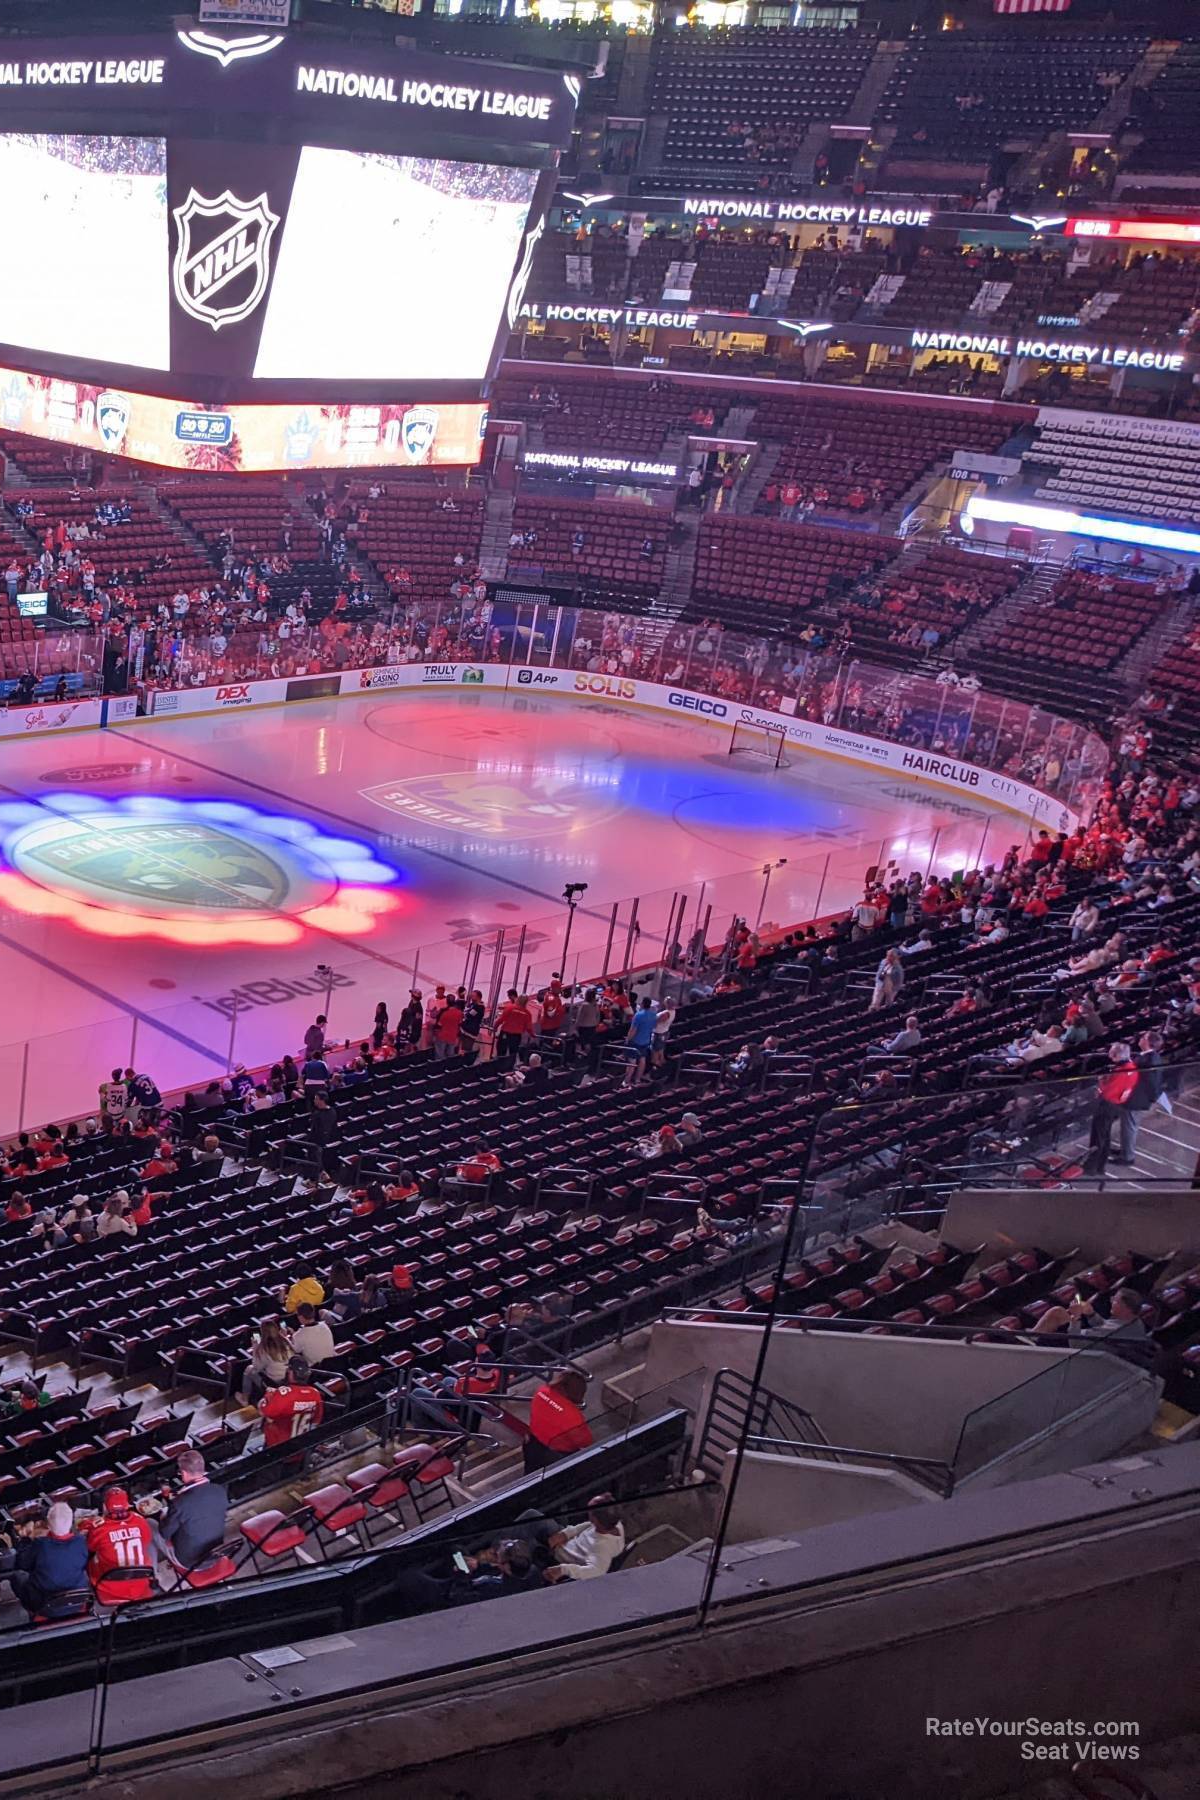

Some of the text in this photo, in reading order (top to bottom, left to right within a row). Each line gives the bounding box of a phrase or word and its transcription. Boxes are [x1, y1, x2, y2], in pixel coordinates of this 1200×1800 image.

[26, 62, 93, 84] HOCKEY
[95, 60, 165, 83] LEAGUE
[297, 67, 552, 120] NATIONAL HOCKEY LEAGUE
[684, 199, 933, 227] NATIONAL HOCKEY LEAGUE
[193, 229, 256, 297] NHL
[547, 305, 623, 324] HOCKEY
[625, 310, 700, 329] LEAGUE
[911, 331, 1185, 371] NATIONAL HOCKEY LEAGUE
[181, 419, 225, 434] 50 50
[1101, 417, 1128, 428] NEXT
[525, 452, 677, 476] NATIONAL HOCKEY LEAGUE
[951, 469, 968, 480] 108
[372, 673, 400, 684] CASINO
[424, 665, 458, 675] TRULY
[215, 684, 250, 701] DEX
[574, 673, 637, 699] SOLIS
[668, 692, 728, 717] GEICO
[902, 753, 981, 786] HAIRCLUB
[991, 778, 1022, 797] CITY
[384, 792, 510, 833] PANTHERS
[1028, 793, 1051, 812] CITY
[54, 827, 201, 863] PANTHERS
[191, 971, 356, 1021] jetBlue
[110, 1094, 123, 1107] 34
[238, 1084, 251, 1096] 22
[290, 1413, 312, 1439] 16
[109, 1527, 142, 1541] DUCLAIR
[114, 1538, 144, 1566] 10
